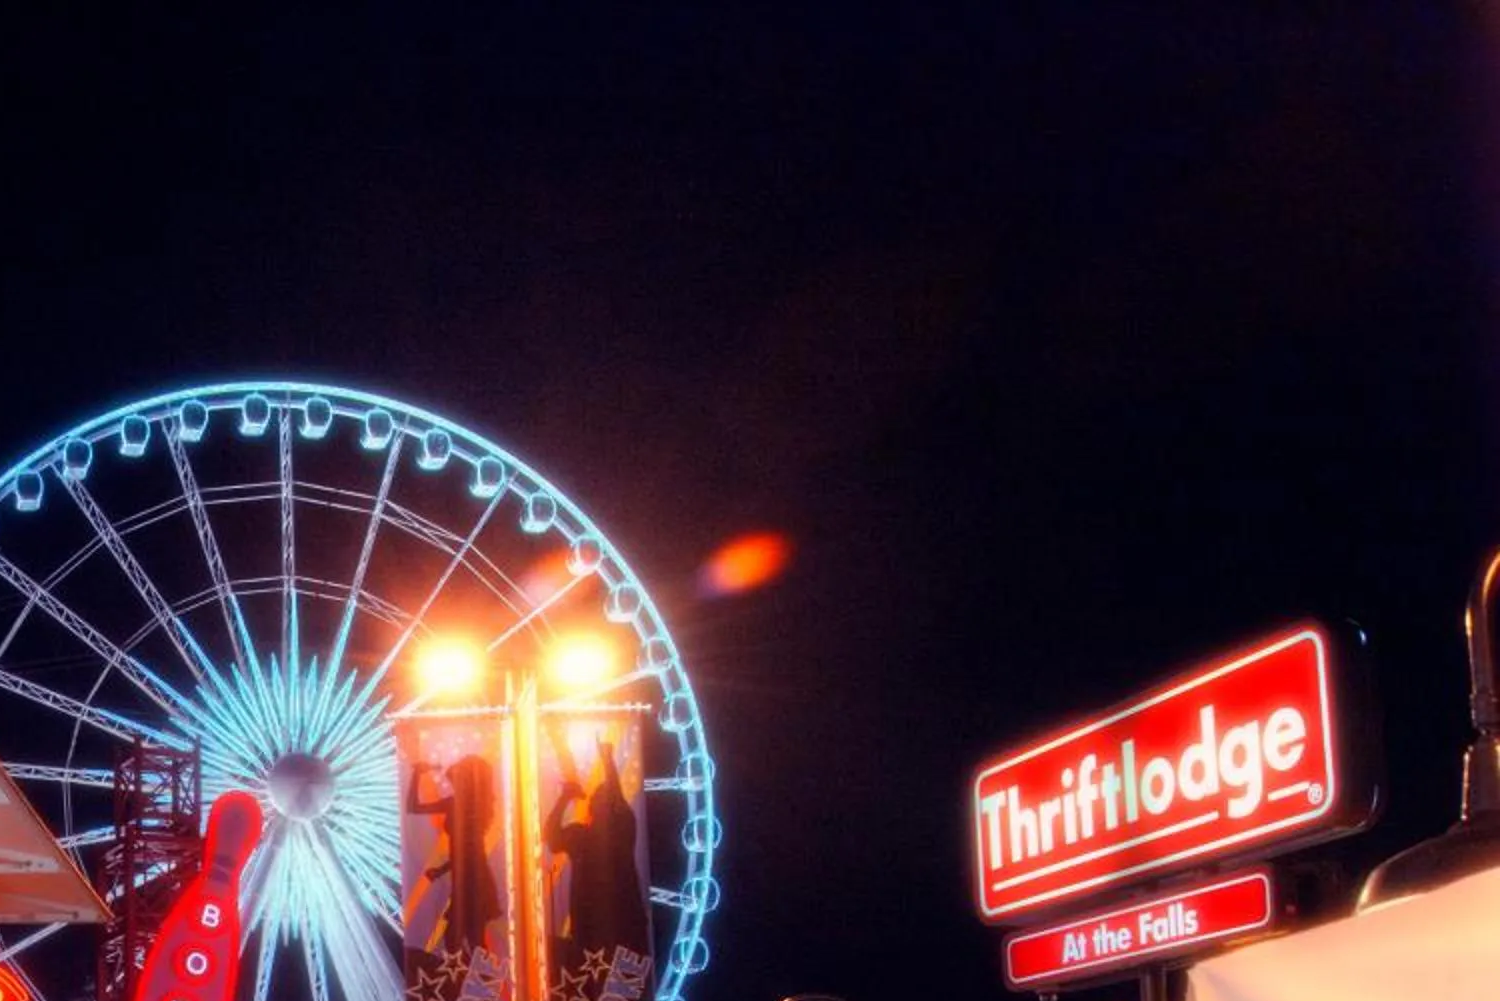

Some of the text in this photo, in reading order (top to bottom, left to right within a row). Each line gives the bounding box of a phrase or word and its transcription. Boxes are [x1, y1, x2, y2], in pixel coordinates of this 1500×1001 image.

[981, 705, 1307, 871] Thriftlodge
[1062, 902, 1200, 965] At the Falls
